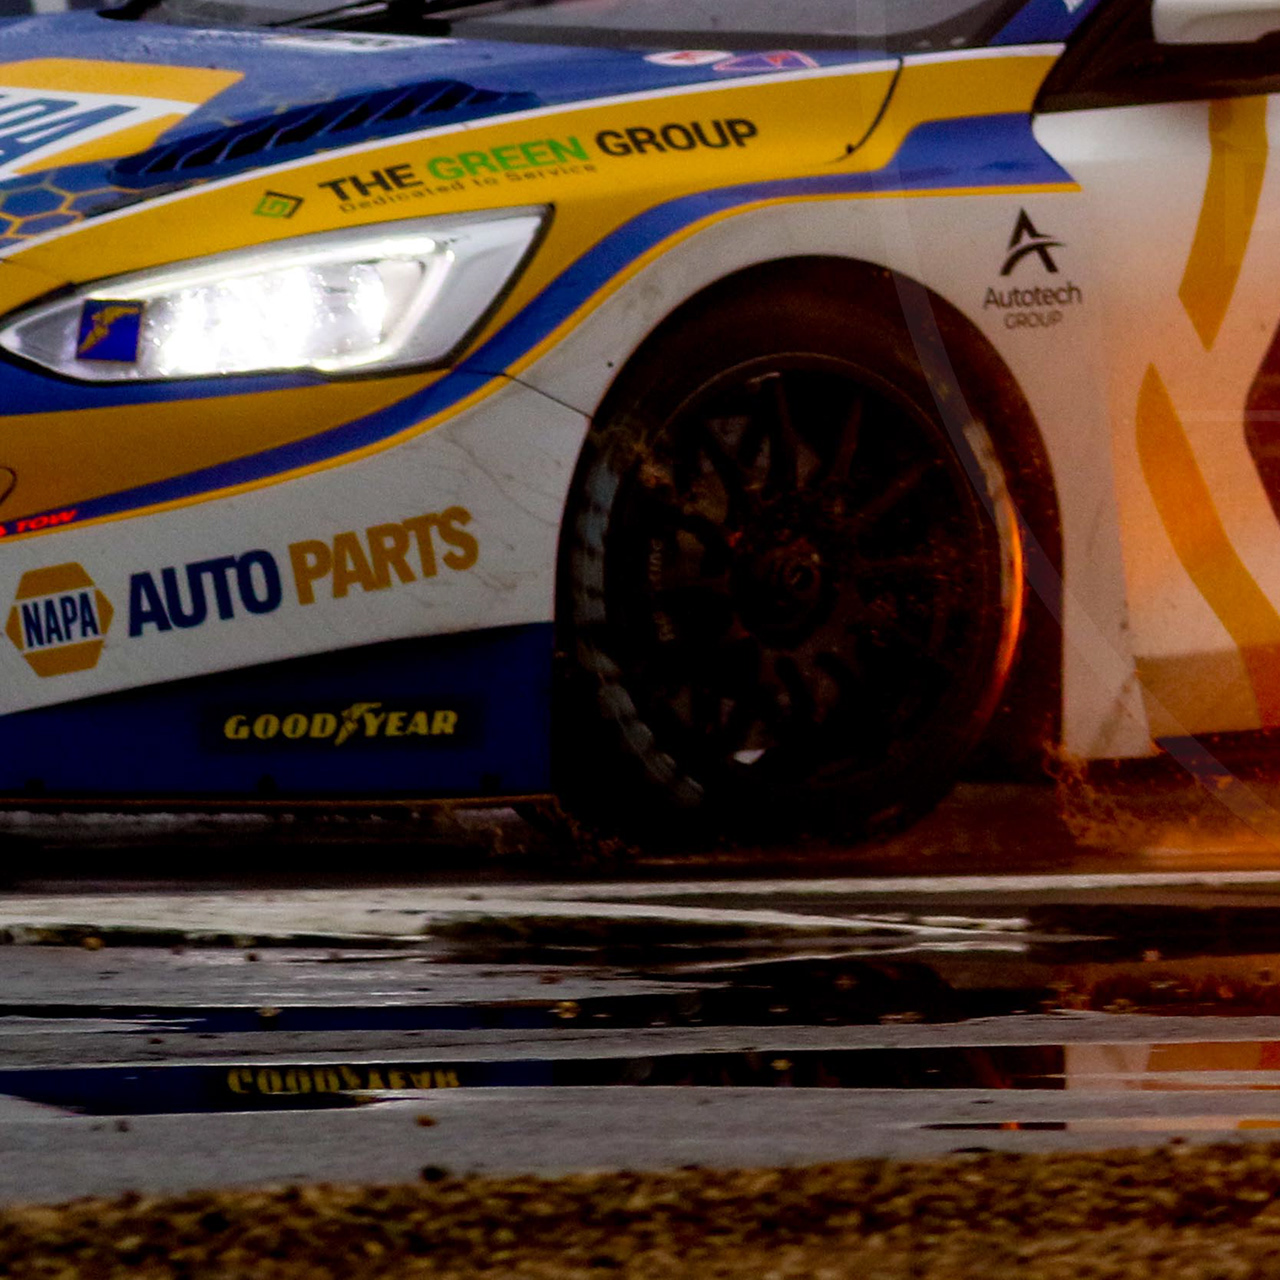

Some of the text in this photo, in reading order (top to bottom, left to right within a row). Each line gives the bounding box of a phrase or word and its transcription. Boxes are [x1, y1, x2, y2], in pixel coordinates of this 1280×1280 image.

[319, 117, 760, 203] THE GREEN GROUP
[339, 162, 599, 214] Dedicated to Service
[983, 281, 1083, 311] Autotech
[1004, 309, 1064, 330] GROUP
[128, 505, 480, 637] AUTO PARTS
[21, 588, 97, 649] NAPA
[223, 703, 459, 745] GOODYEAR
